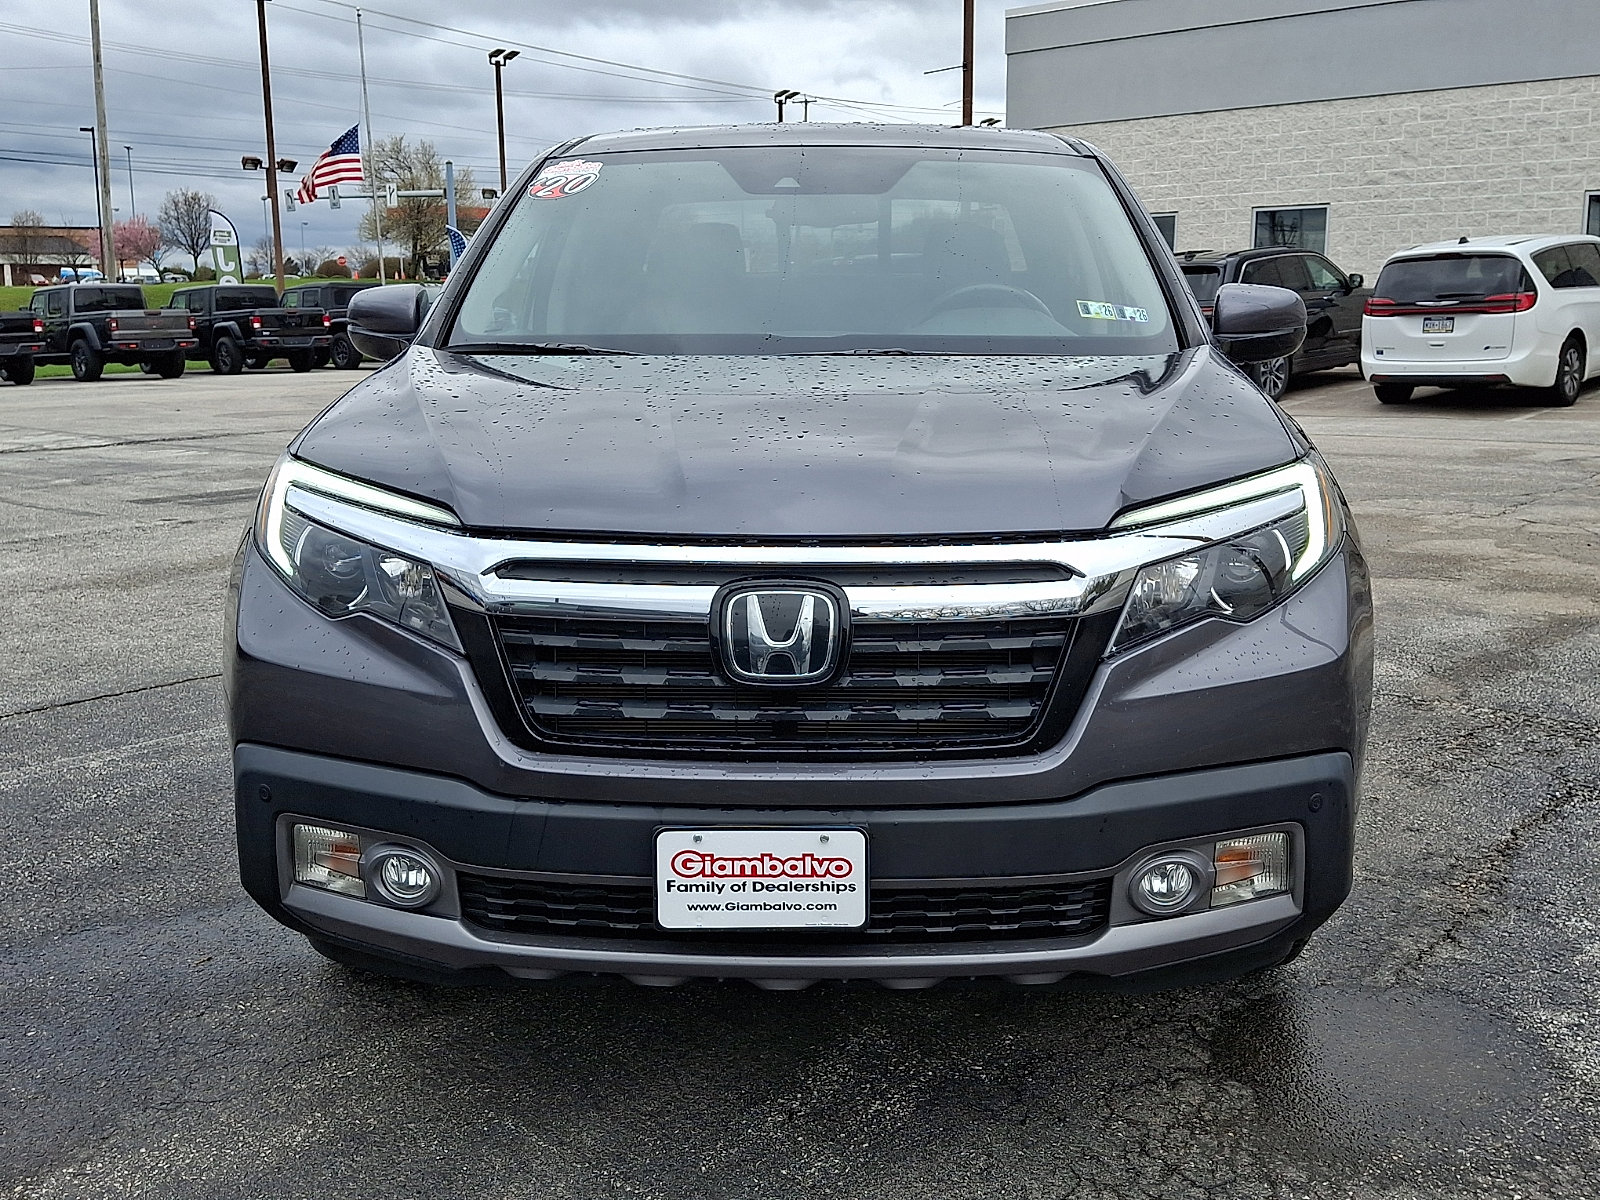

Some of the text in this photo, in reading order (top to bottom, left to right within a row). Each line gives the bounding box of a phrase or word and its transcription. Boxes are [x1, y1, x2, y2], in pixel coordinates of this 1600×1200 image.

[670, 849, 853, 878] Giambalvo
[666, 879, 857, 895] Family of Dealerships
[687, 901, 838, 911] www.Giambalvo.com
